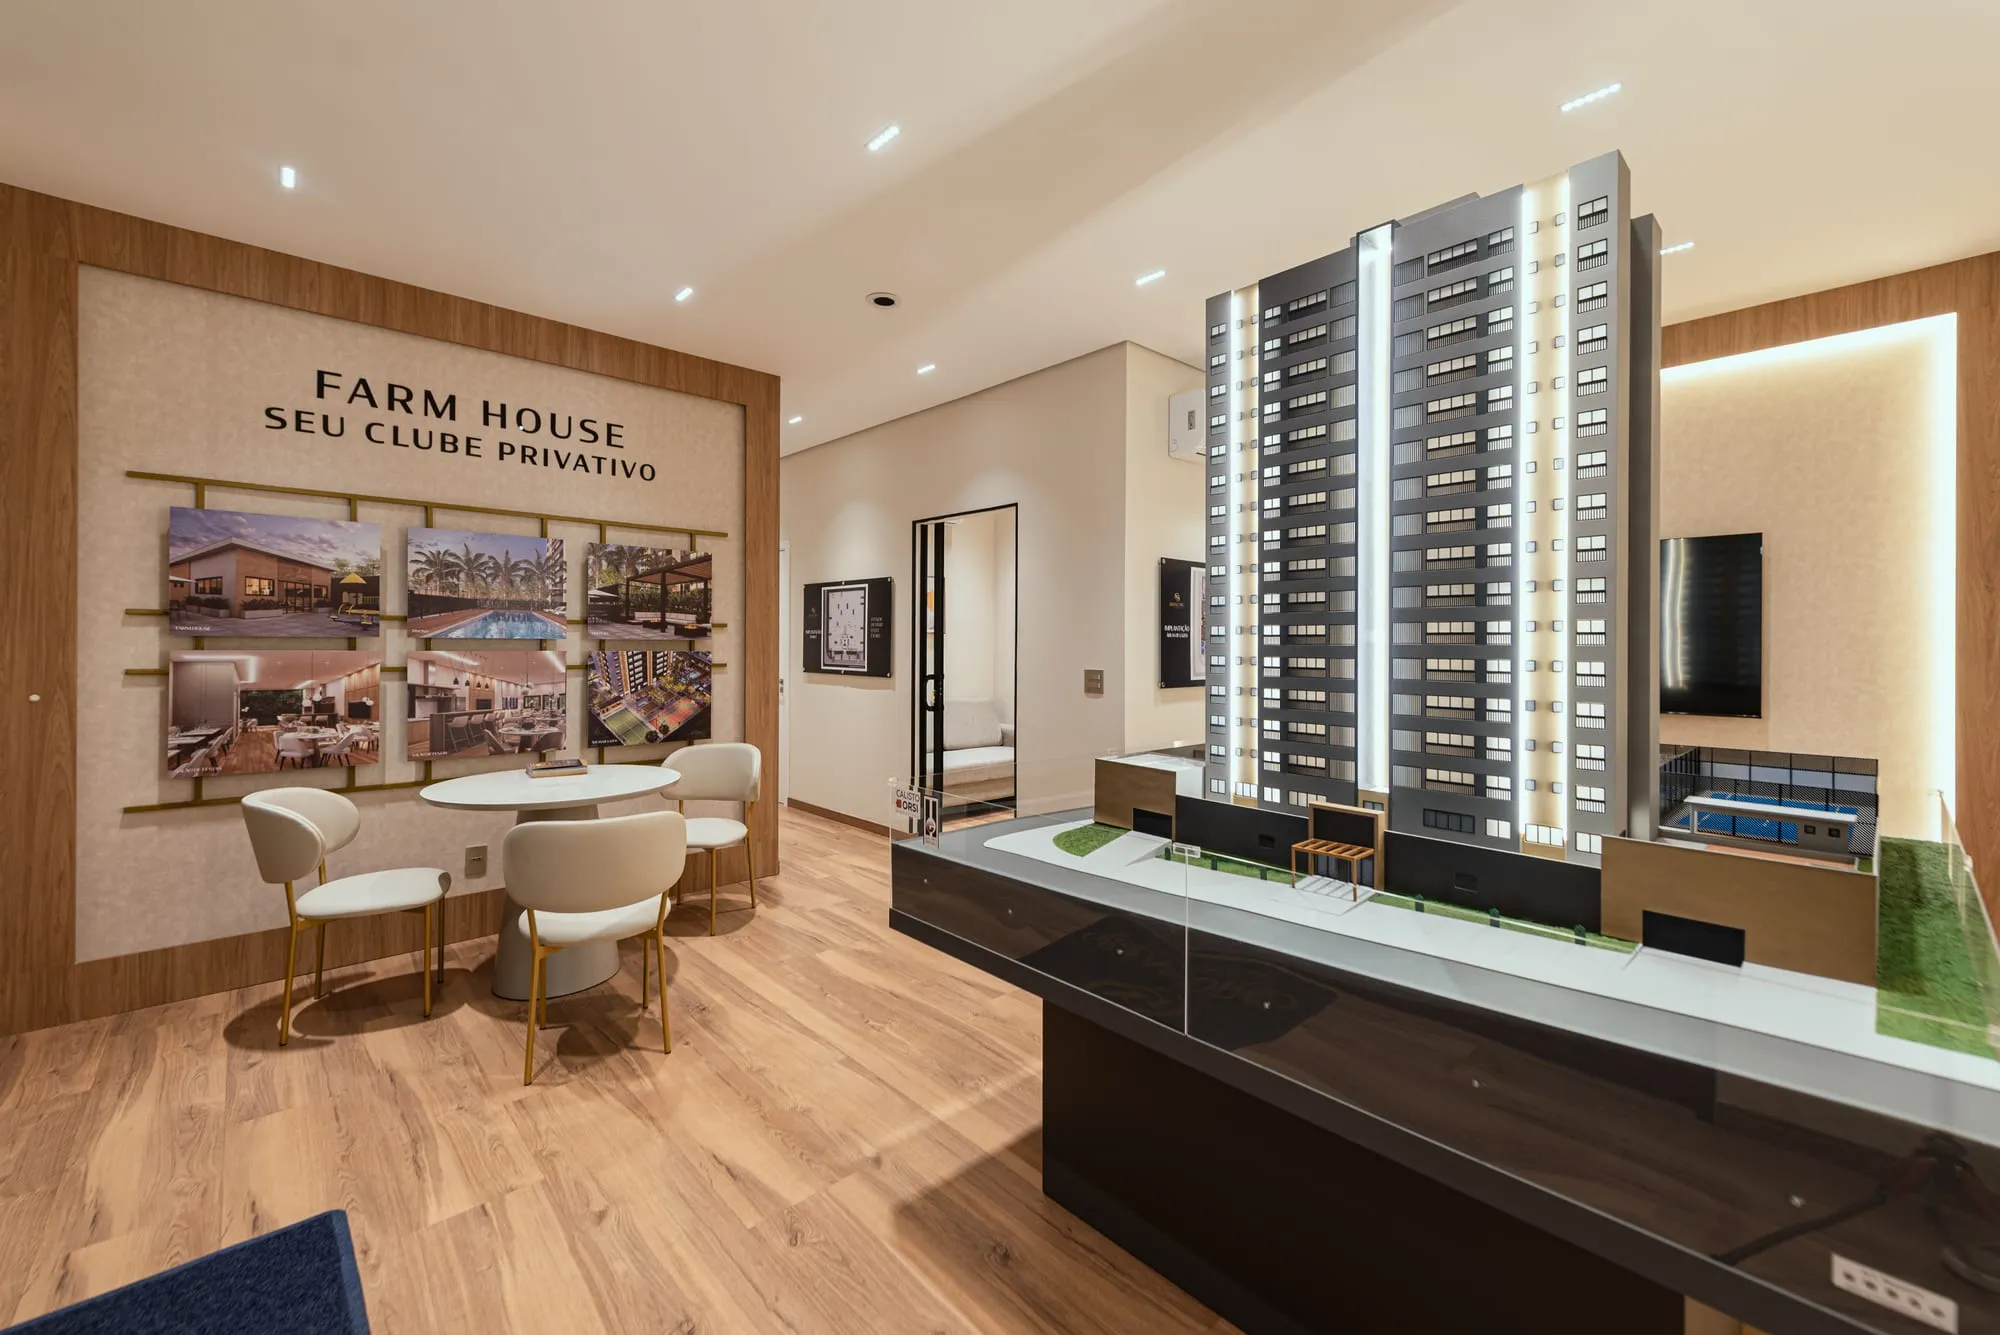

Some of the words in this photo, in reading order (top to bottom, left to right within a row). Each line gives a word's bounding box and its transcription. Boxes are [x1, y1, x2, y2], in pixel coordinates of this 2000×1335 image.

[316, 369, 457, 422] FARM
[482, 399, 625, 449] HOUSE
[264, 406, 345, 438] SEU
[365, 422, 482, 458] CLUBE
[498, 441, 656, 482] PRIVATIVO
[896, 789, 920, 802] CALISTO
[902, 801, 919, 814] ORSI
